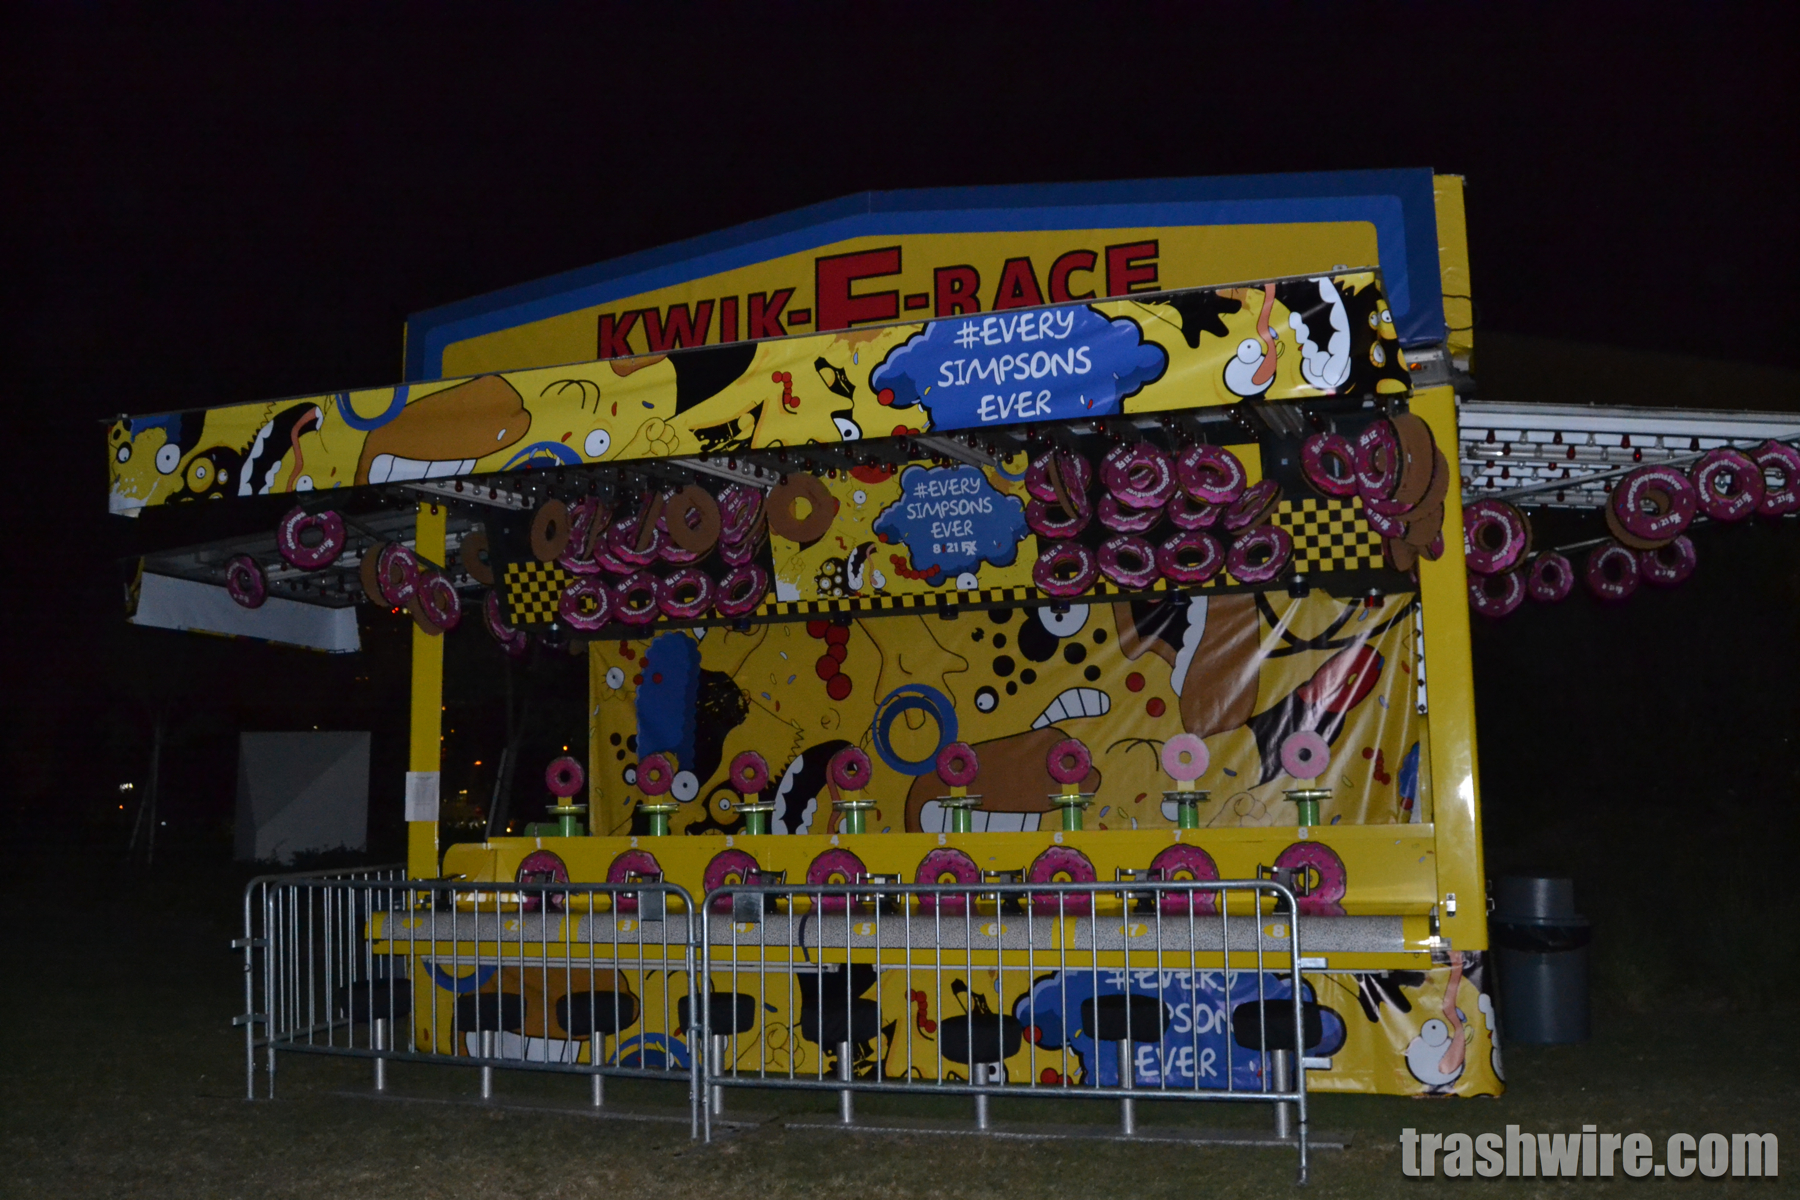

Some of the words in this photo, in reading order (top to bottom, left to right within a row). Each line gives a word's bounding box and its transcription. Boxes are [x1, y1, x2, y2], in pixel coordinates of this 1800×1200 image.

[954, 310, 1075, 349] #EVERY
[937, 346, 1092, 387] SIMPSONS
[977, 389, 1051, 421] EVER
[913, 477, 981, 498] #EVERY
[907, 497, 993, 519] SIMPSONS
[931, 519, 973, 539] EVER
[1053, 832, 1063, 843] 6
[1173, 829, 1182, 841] 7
[1298, 827, 1308, 839] 8
[631, 837, 639, 848] 2
[725, 836, 734, 847] 3
[830, 836, 840, 846] 4
[938, 835, 946, 845] 5
[622, 919, 632, 931] 3
[861, 923, 871, 935] 5
[1129, 924, 1140, 936] 7
[1273, 924, 1284, 937] 8
[1134, 1046, 1218, 1078] EVER
